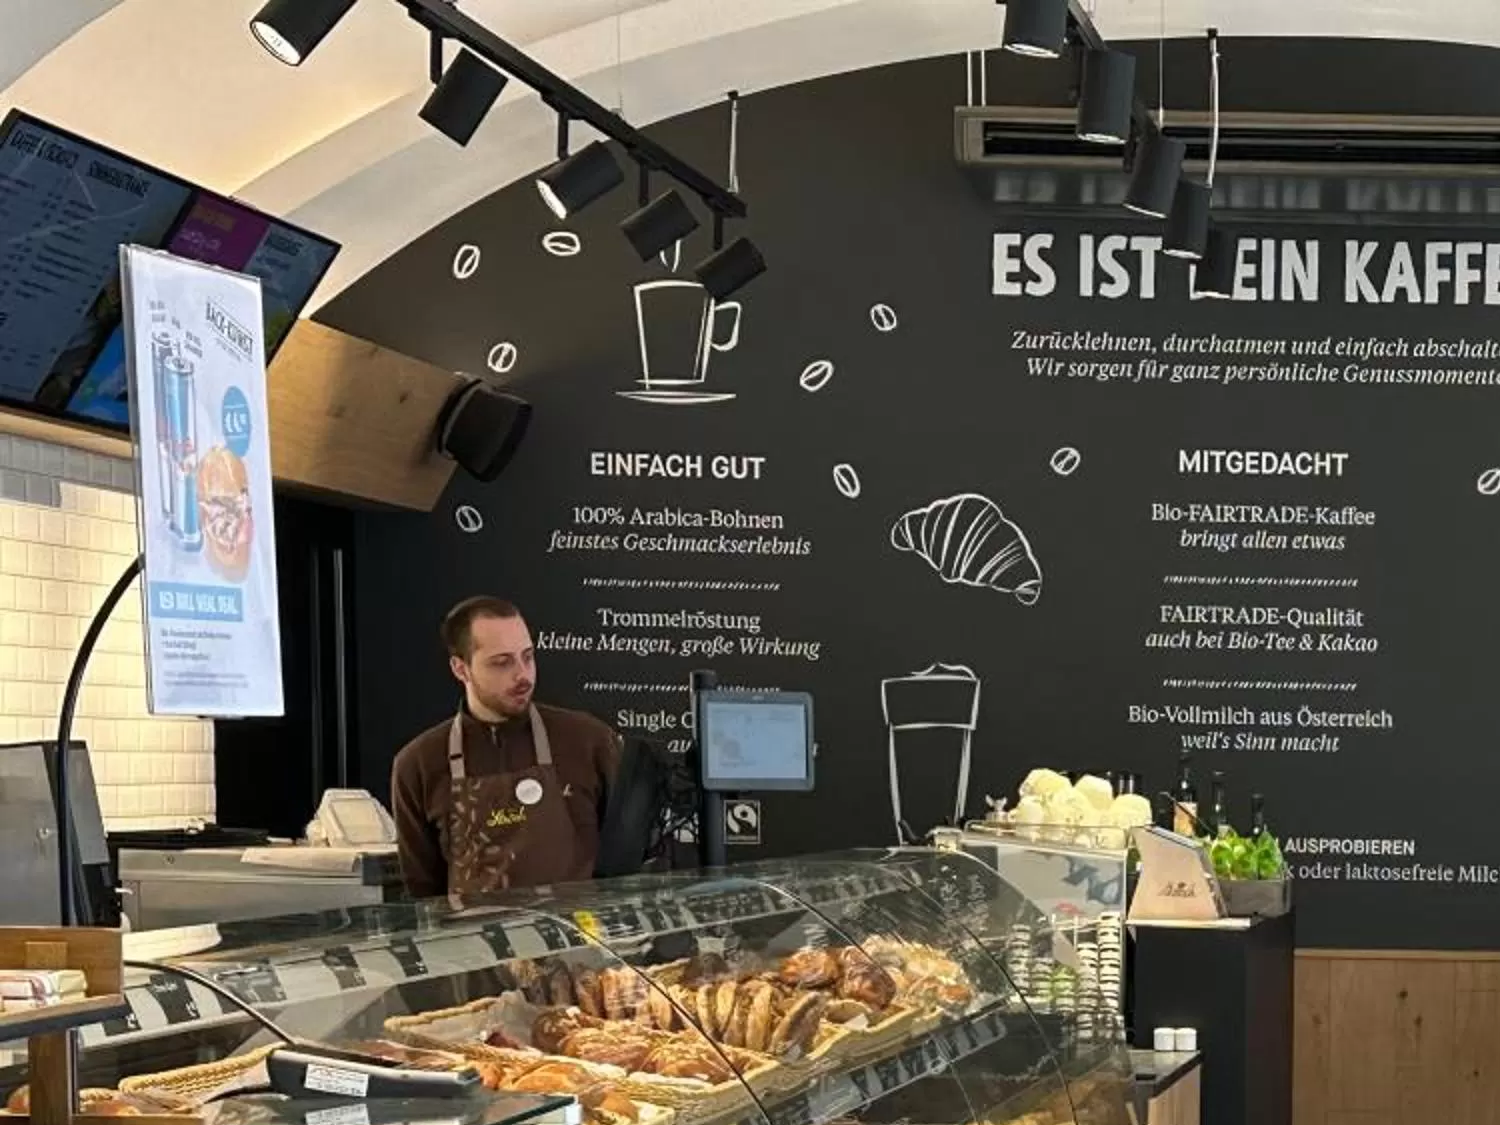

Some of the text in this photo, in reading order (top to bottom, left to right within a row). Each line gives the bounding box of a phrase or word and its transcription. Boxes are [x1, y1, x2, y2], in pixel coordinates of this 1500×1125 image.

[992, 233, 1054, 296] ES
[1079, 234, 1161, 299] IST
[1012, 328, 1158, 354] Zurücklehnen,
[1162, 332, 1285, 355] durchatmen
[1291, 336, 1331, 356] und
[1335, 336, 1409, 360] einfach
[1026, 357, 1064, 379] Wir
[1068, 360, 1133, 383] sorgen
[1133, 360, 1168, 383] für
[1170, 364, 1220, 385] ganz
[1223, 361, 1339, 385] persönliche
[591, 453, 765, 479] EINFACH GUT
[1179, 450, 1348, 476] MITGEDACHT
[573, 507, 783, 529] 100% Arabica-Bohnen
[1152, 504, 1376, 525] Bio-FAIRTRADE-Kaffee
[547, 531, 811, 555] feinstes Geschmackserlebnis
[1180, 529, 1345, 552] bringt allen etwas
[597, 608, 760, 632] Trommelröstung
[1160, 605, 1363, 628] FAIRTRADE-Qualität
[537, 632, 821, 660] kleine Mengen, große Wirkung
[1145, 631, 1378, 653] auch bei Bio-Tee & Kakao
[617, 709, 677, 732] Single
[1129, 705, 1393, 728] Bio-Vollmilch aus Österreich
[1181, 732, 1340, 752] weil's Sinn macht
[1285, 838, 1416, 856] AUSPROBIEREN
[1298, 863, 1341, 881] oder
[1345, 864, 1454, 883] laktosefreie
